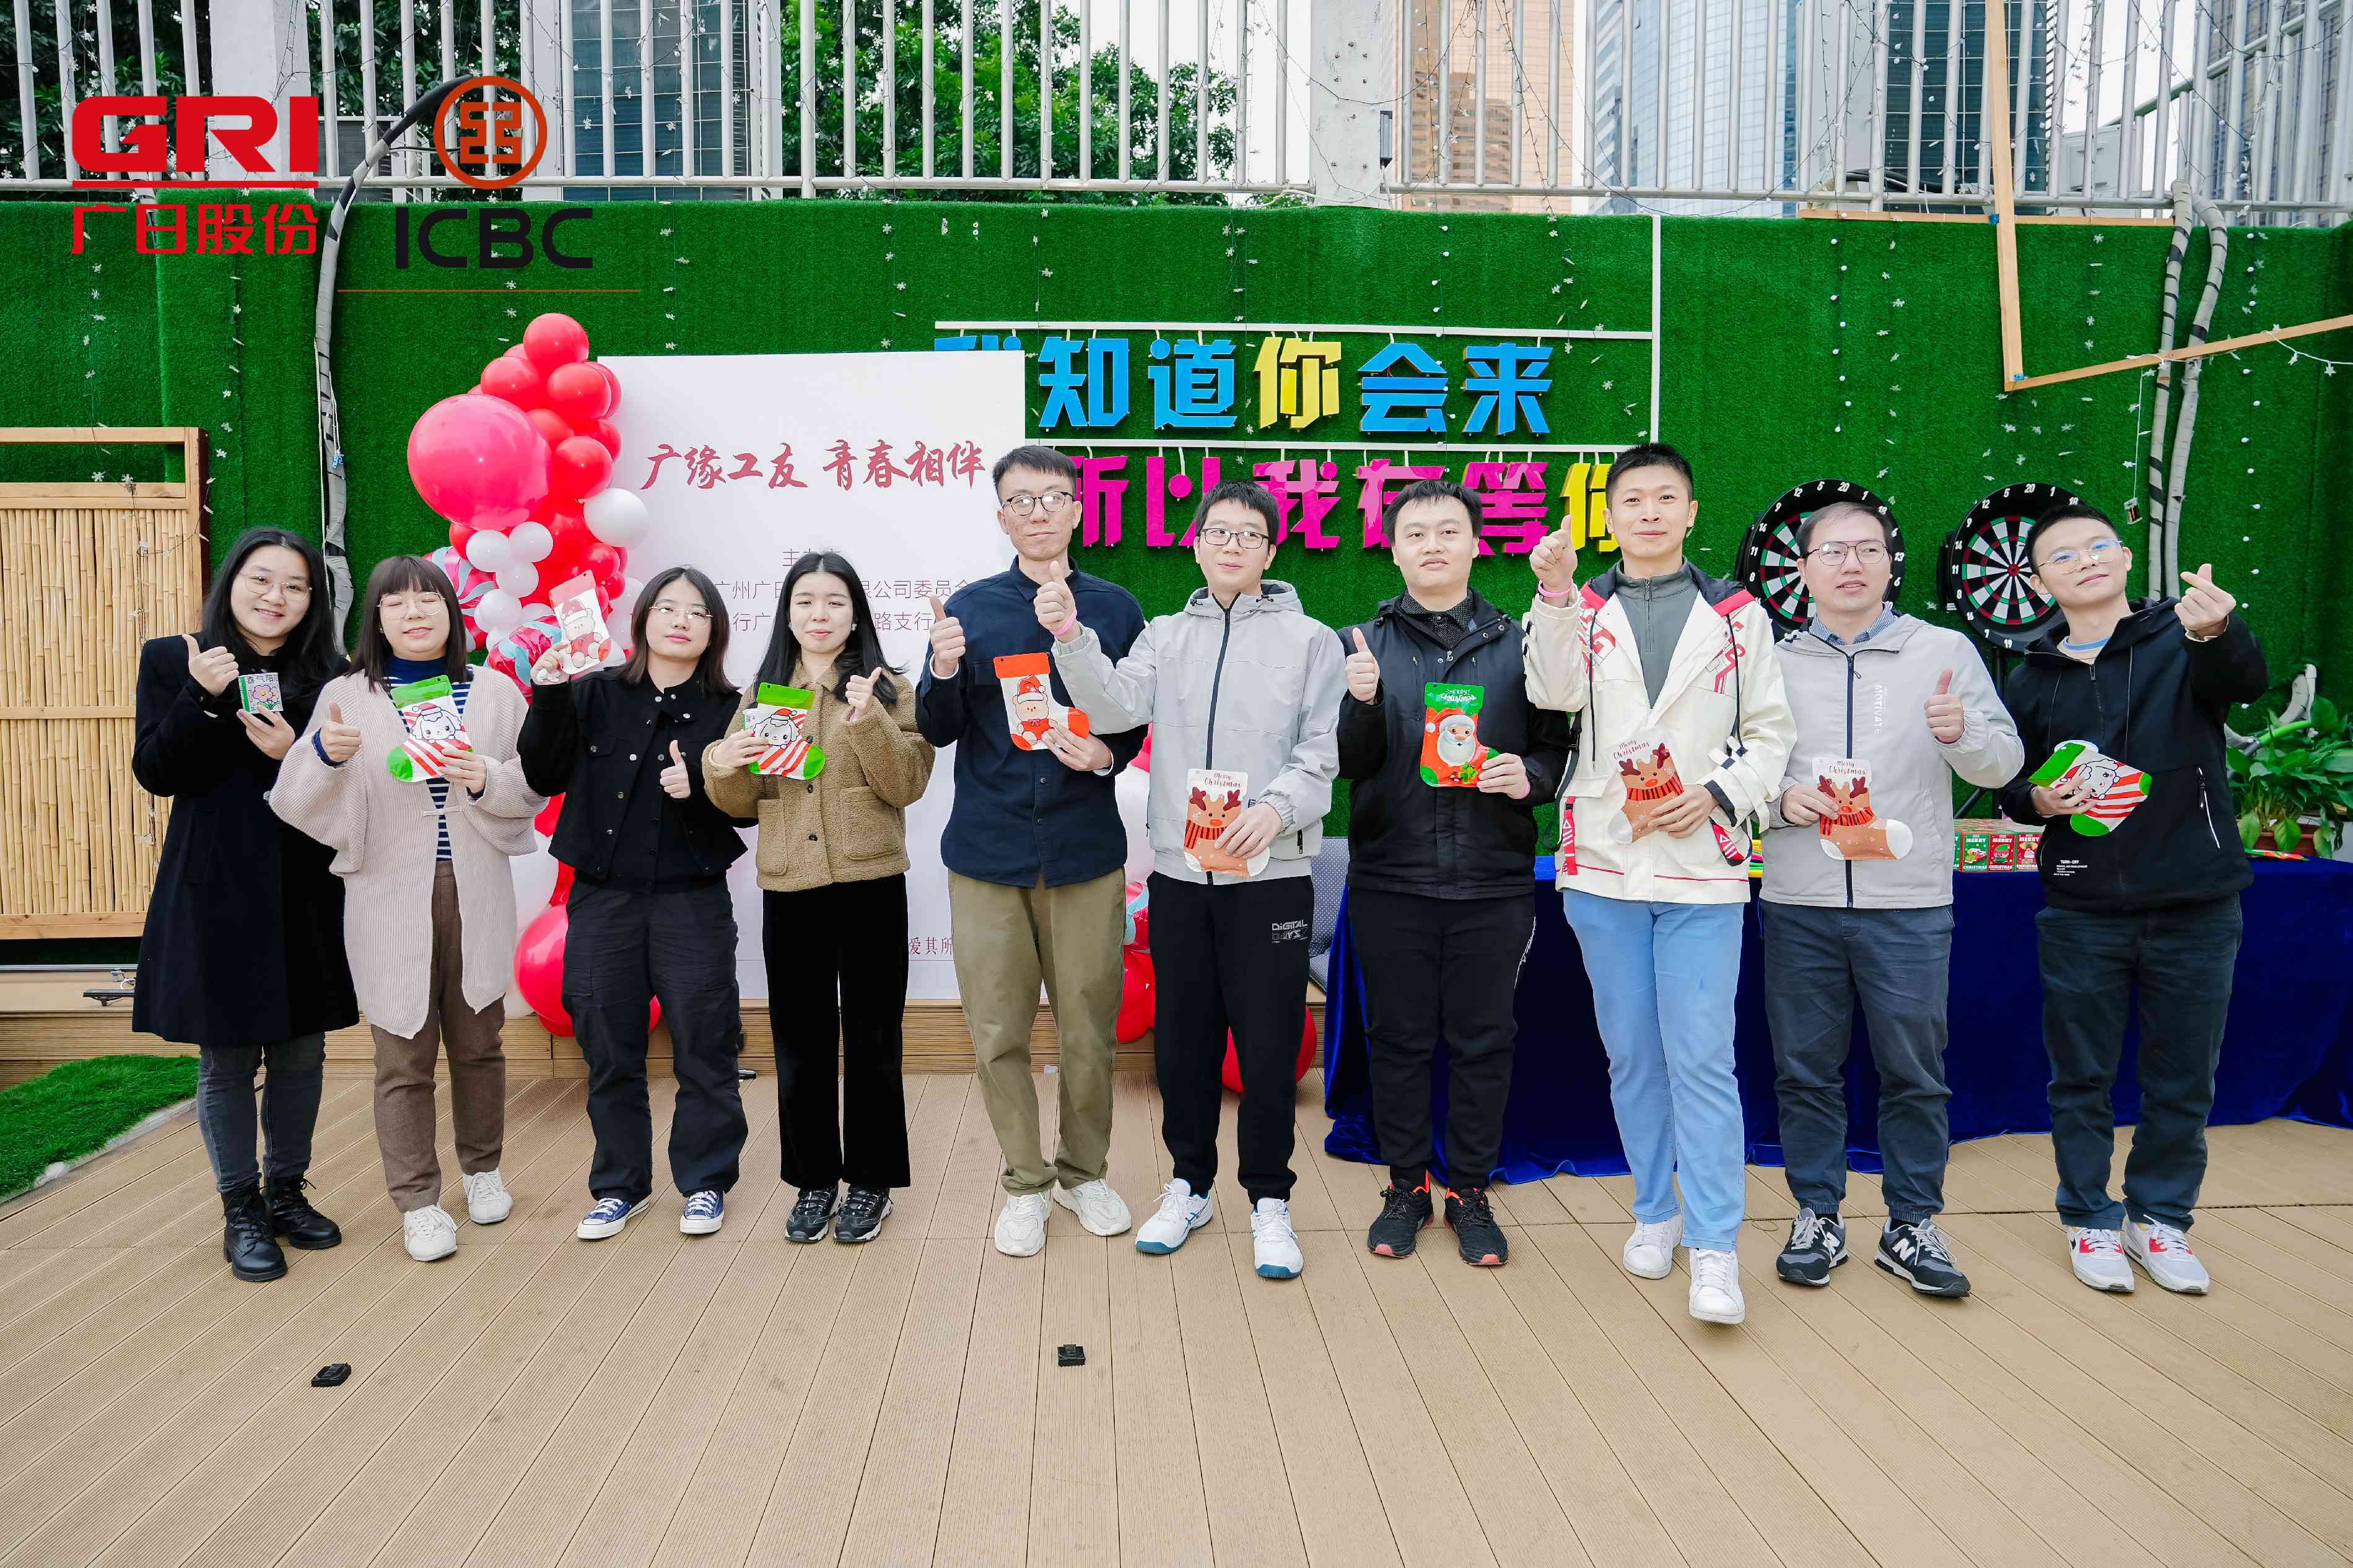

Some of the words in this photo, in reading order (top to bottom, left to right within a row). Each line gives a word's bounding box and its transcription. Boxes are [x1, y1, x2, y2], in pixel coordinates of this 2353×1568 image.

[935, 335, 1553, 435] 知道你会来
[640, 443, 808, 490] 广缘工友
[823, 439, 985, 490] 青春相伴
[1817, 481, 1825, 490] 5
[1838, 482, 1849, 492] 20
[2025, 483, 2036, 493] 20
[1794, 488, 1802, 497] 12
[1862, 491, 1869, 500] 1
[2004, 488, 2010, 497] 5
[2050, 487, 2056, 496] 1
[1775, 503, 1781, 512] 9
[1982, 499, 1990, 508] 12
[1878, 505, 1887, 515] 18
[1967, 518, 1972, 527] 9
[1759, 523, 1767, 532] 14
[1955, 541, 1962, 550] 14
[1751, 547, 1758, 555] 11
[1894, 552, 1905, 561] 13
[1952, 565, 1959, 574] 11
[1749, 572, 1755, 581] 8
[1894, 577, 1900, 586] 6
[1957, 590, 1962, 599] 8
[1967, 612, 1974, 621] 16
[1984, 629, 1989, 638] 7
[2004, 639, 2012, 648] 19
[1205, 778, 1241, 788] Christmas
